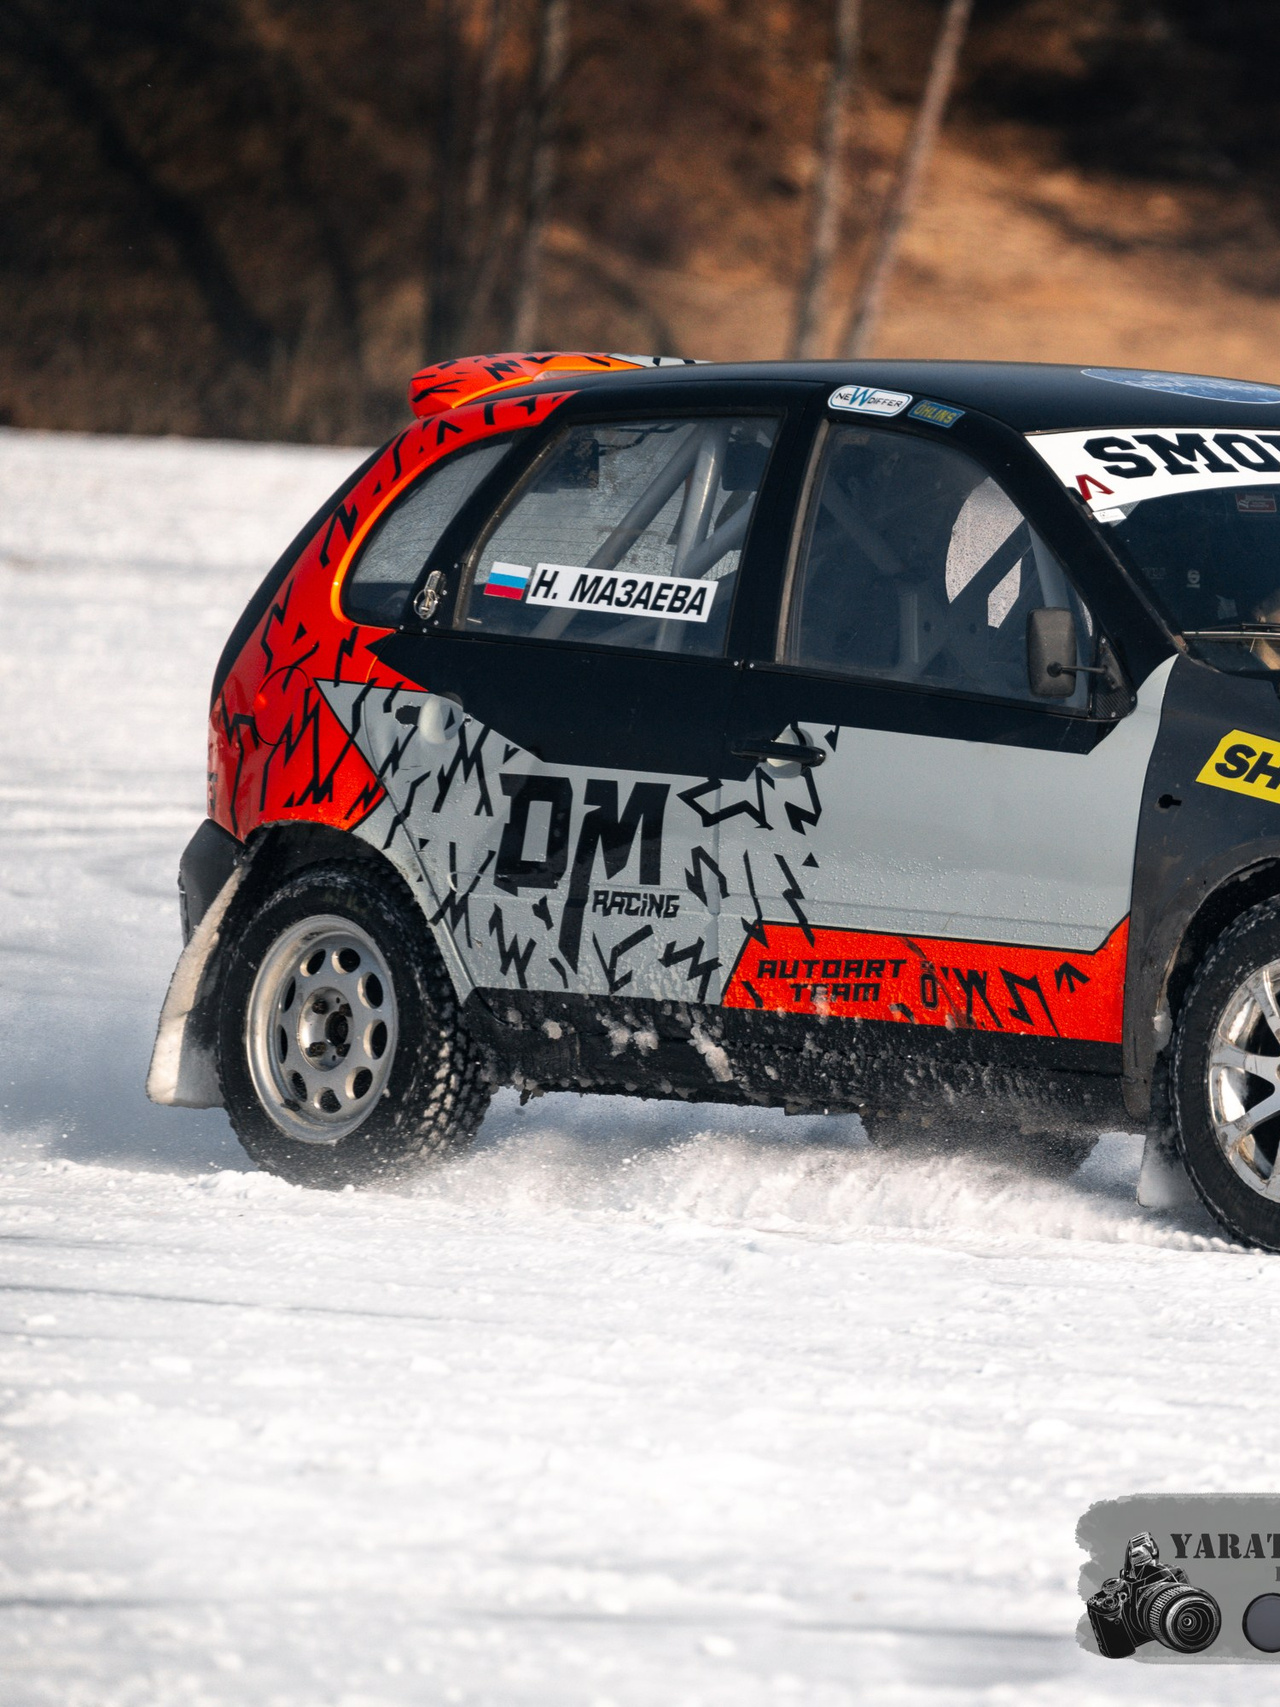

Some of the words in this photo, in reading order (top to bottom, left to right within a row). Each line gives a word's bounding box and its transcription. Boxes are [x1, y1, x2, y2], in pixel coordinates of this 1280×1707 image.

[867, 396, 903, 408] DIFFER
[531, 568, 559, 600] Н.
[568, 573, 708, 616] МАЗАЕВА
[757, 959, 907, 978] AUTOART
[789, 983, 881, 1002] TEAM
